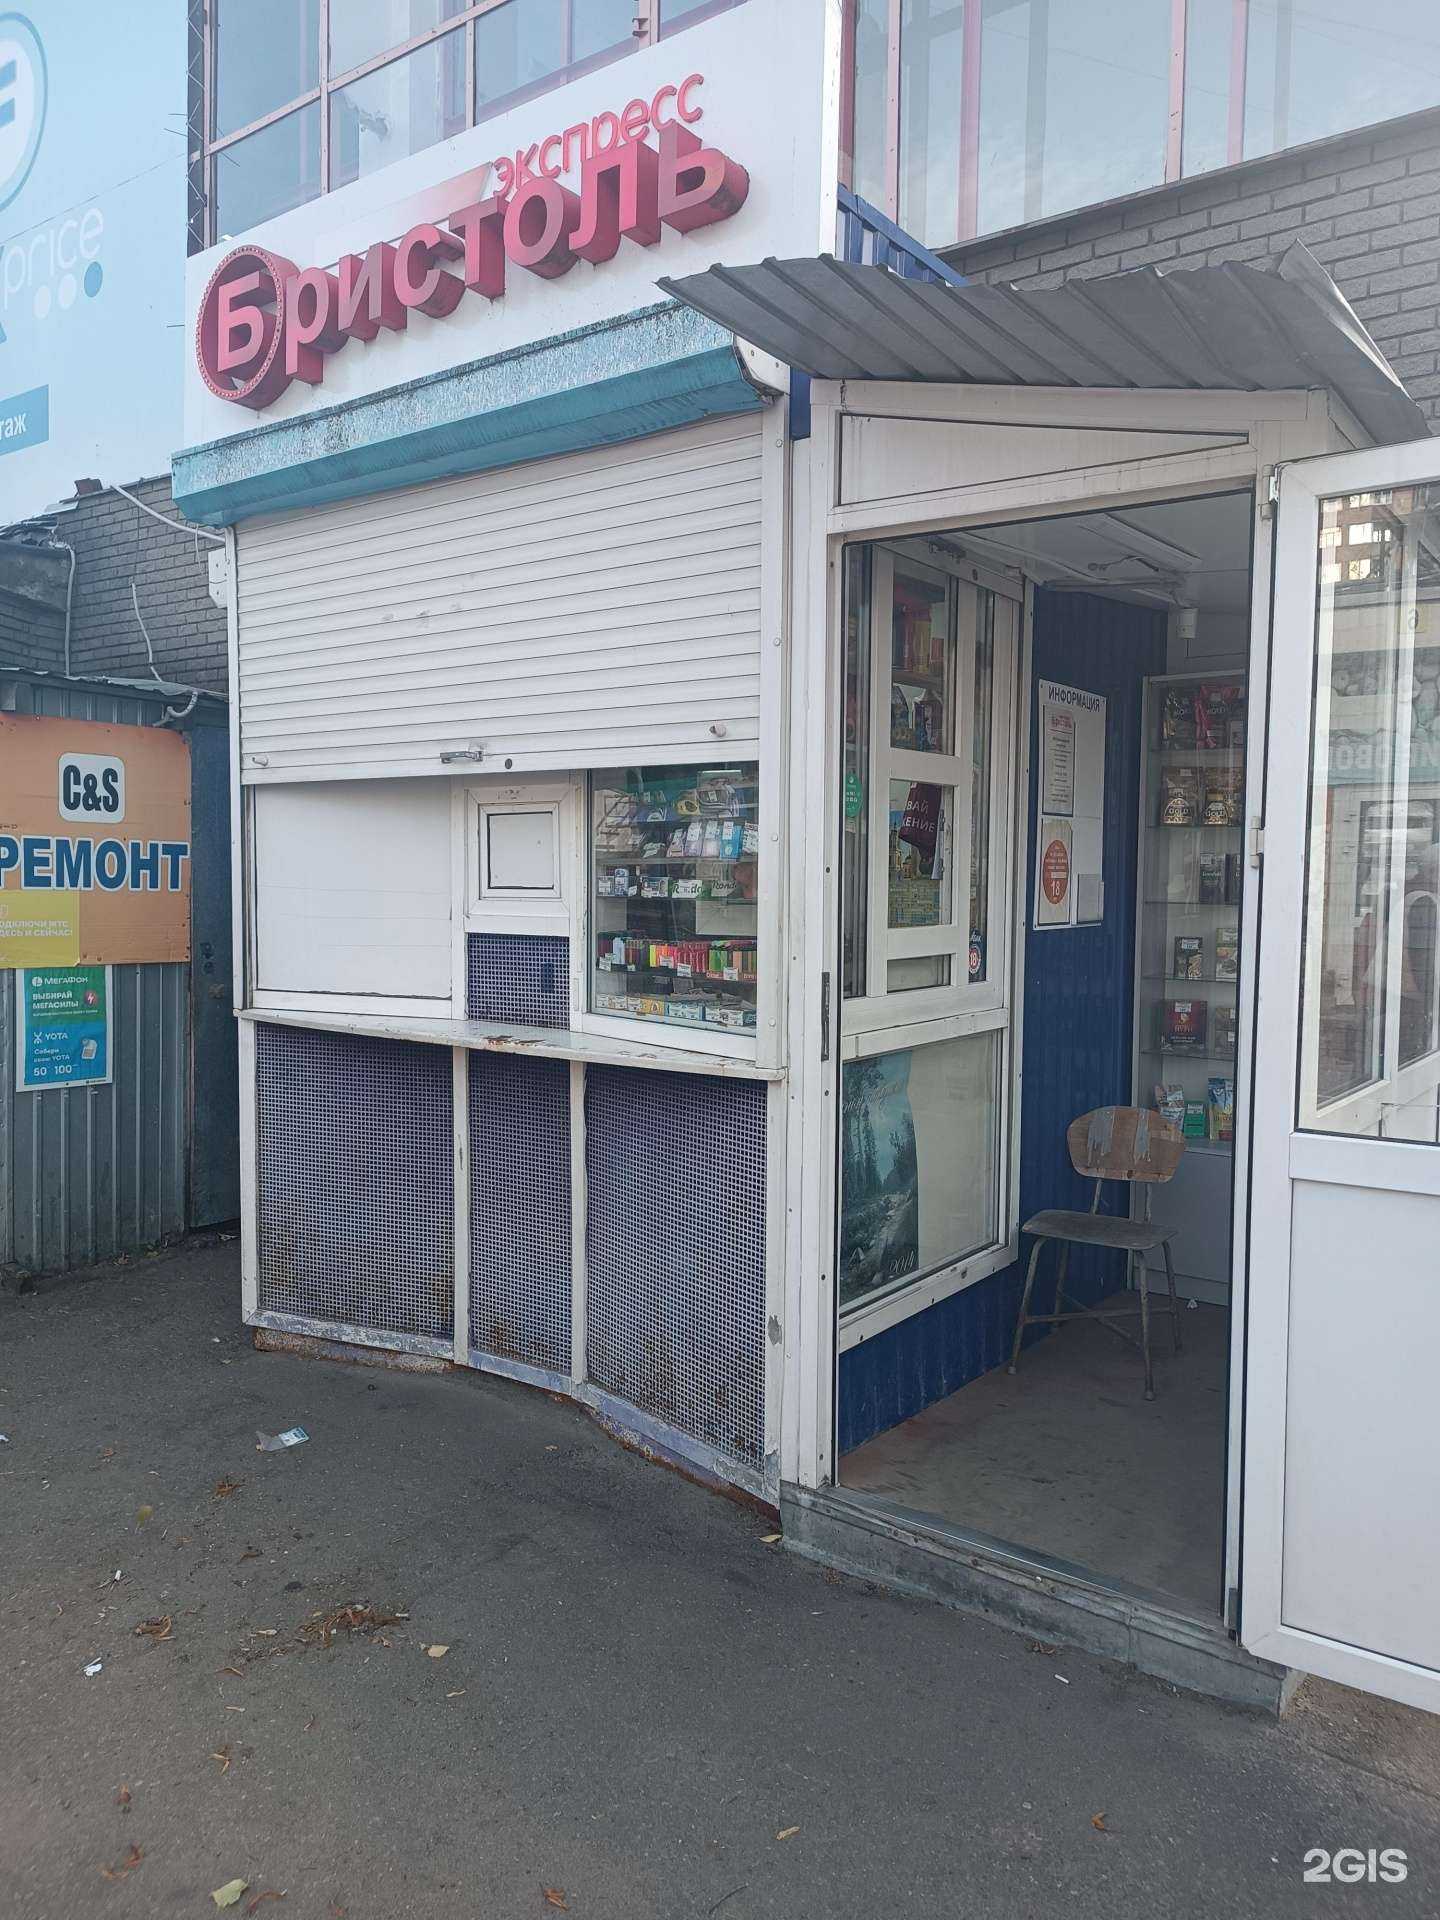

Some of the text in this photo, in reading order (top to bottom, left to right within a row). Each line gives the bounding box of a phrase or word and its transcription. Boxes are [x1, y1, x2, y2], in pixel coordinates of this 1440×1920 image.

[492, 72, 705, 198] экспресс
[3, 207, 104, 311] price
[1048, 686, 1100, 712] ИНФОРМАЦИЯ
[63, 765, 120, 814] C&S
[0, 836, 190, 891] РЕМОНТ
